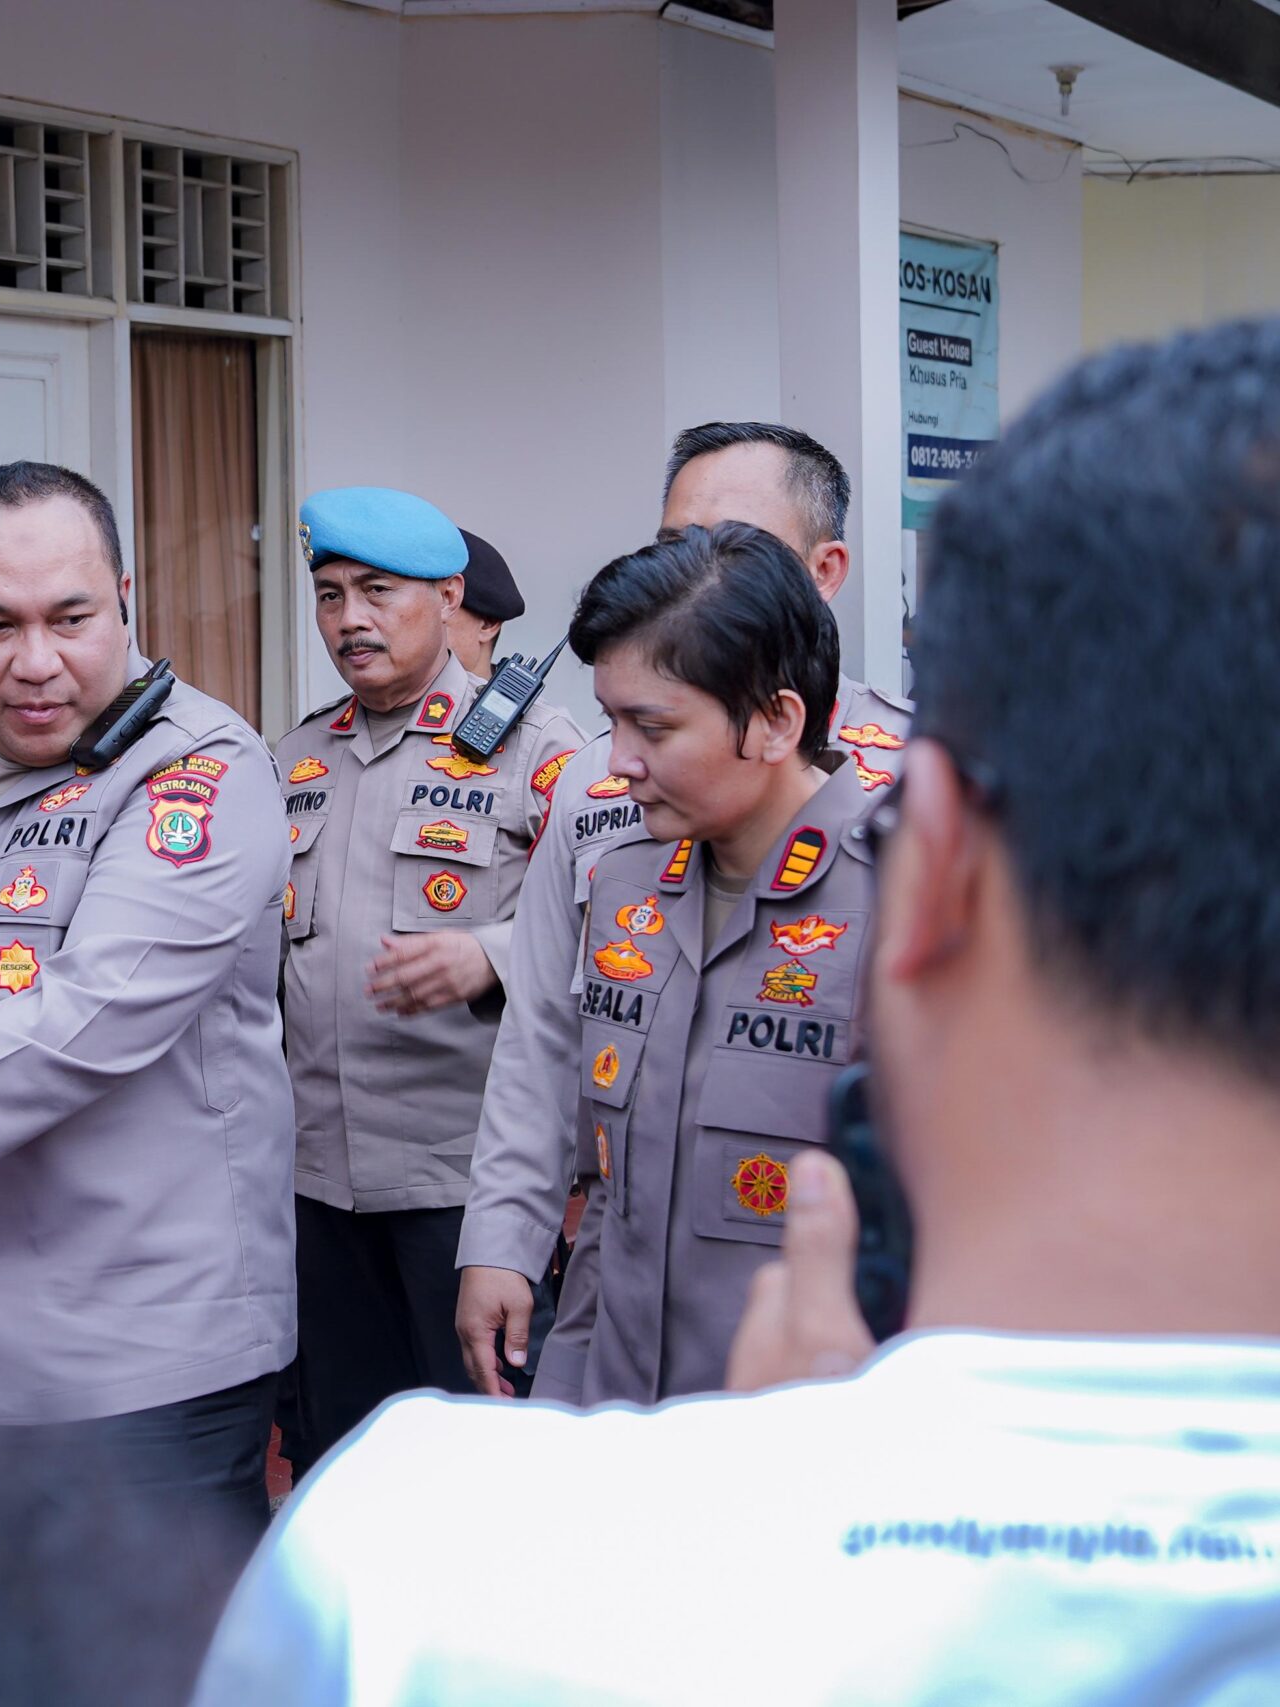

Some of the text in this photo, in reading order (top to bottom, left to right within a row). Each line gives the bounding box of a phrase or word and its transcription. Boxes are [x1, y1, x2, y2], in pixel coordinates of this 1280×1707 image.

[908, 333, 970, 362] Guest House
[909, 364, 967, 390] Khusus Pria
[908, 409, 939, 428] Hubungi
[186, 764, 218, 776] SELATAN
[188, 757, 222, 771] METRO
[151, 779, 212, 798] METRO JAYA
[411, 785, 494, 814] POLRI
[4, 817, 88, 854] POLRI
[575, 804, 642, 840] SUPRIA
[0, 963, 33, 971] RESERSE
[582, 981, 644, 1027] SEALA
[727, 1012, 835, 1058] POLRI
